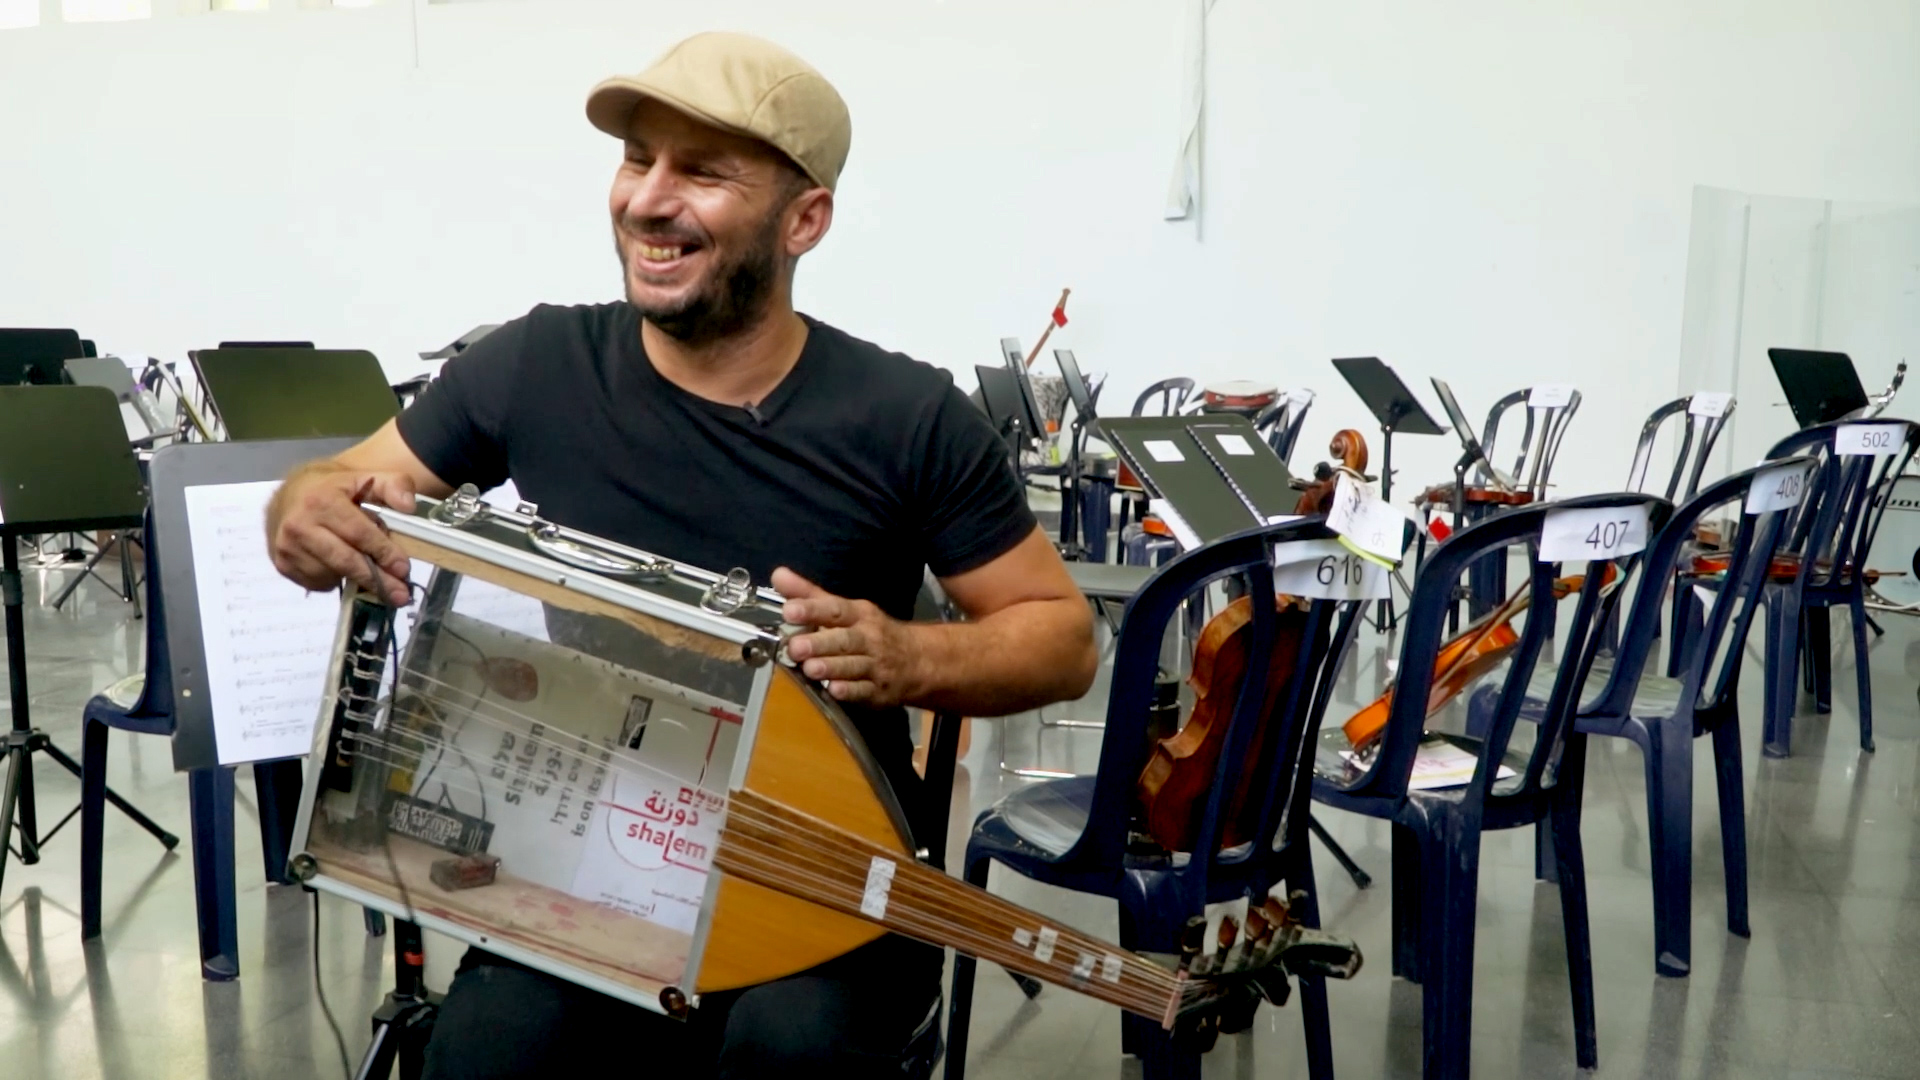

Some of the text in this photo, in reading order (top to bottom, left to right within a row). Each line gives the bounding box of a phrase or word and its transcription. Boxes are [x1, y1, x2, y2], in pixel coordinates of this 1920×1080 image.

[1861, 431, 1891, 449] 502
[1775, 474, 1801, 501] 408
[1585, 520, 1631, 551] 407
[1316, 554, 1364, 586] 616
[579, 799, 595, 822] on
[626, 821, 709, 862] shalem
